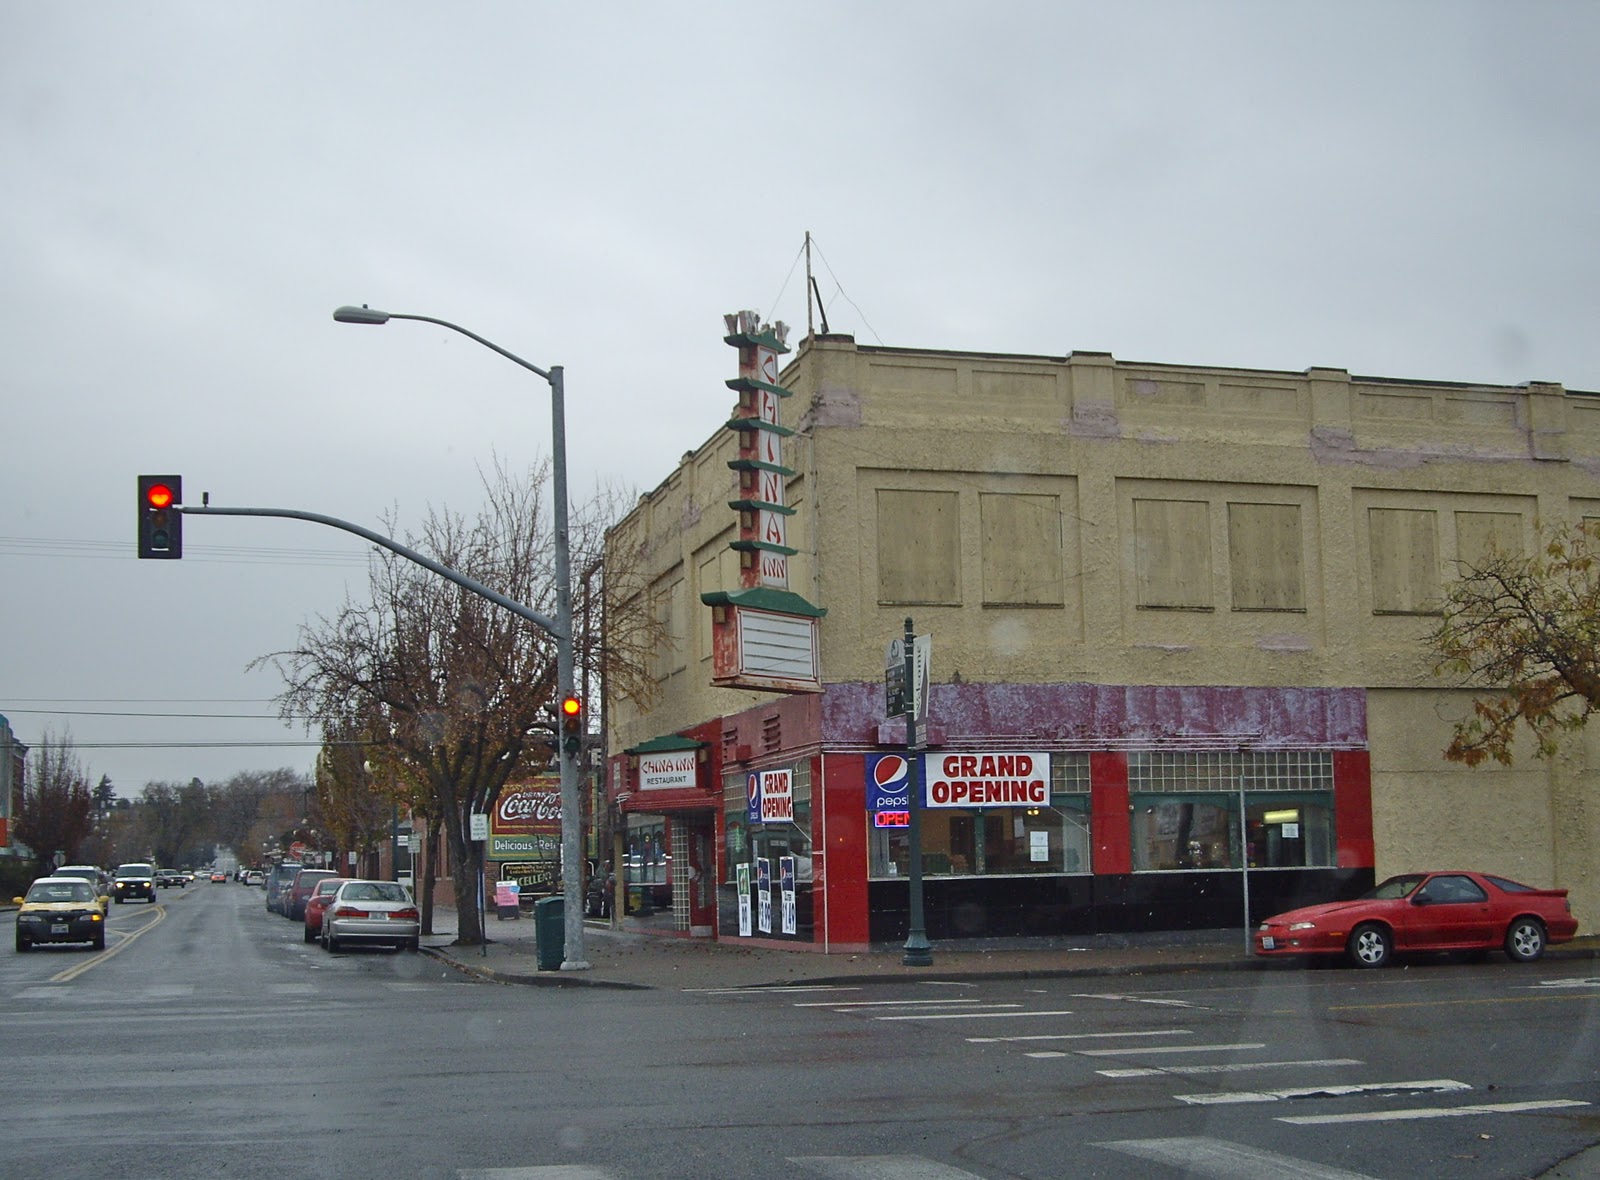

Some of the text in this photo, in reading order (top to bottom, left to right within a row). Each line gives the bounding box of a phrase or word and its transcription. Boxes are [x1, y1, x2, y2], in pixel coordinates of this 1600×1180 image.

[762, 354, 782, 544] CHINA
[763, 556, 785, 578] INN
[641, 757, 695, 774] CHINA INN
[942, 755, 1033, 778] GRAND
[646, 775, 687, 785] RESTAURANT
[764, 772, 789, 795] GRAND
[876, 796, 909, 808] pepsi
[931, 780, 1045, 804] OPENING
[762, 796, 792, 818] OPENING
[494, 840, 533, 850] Delicious
